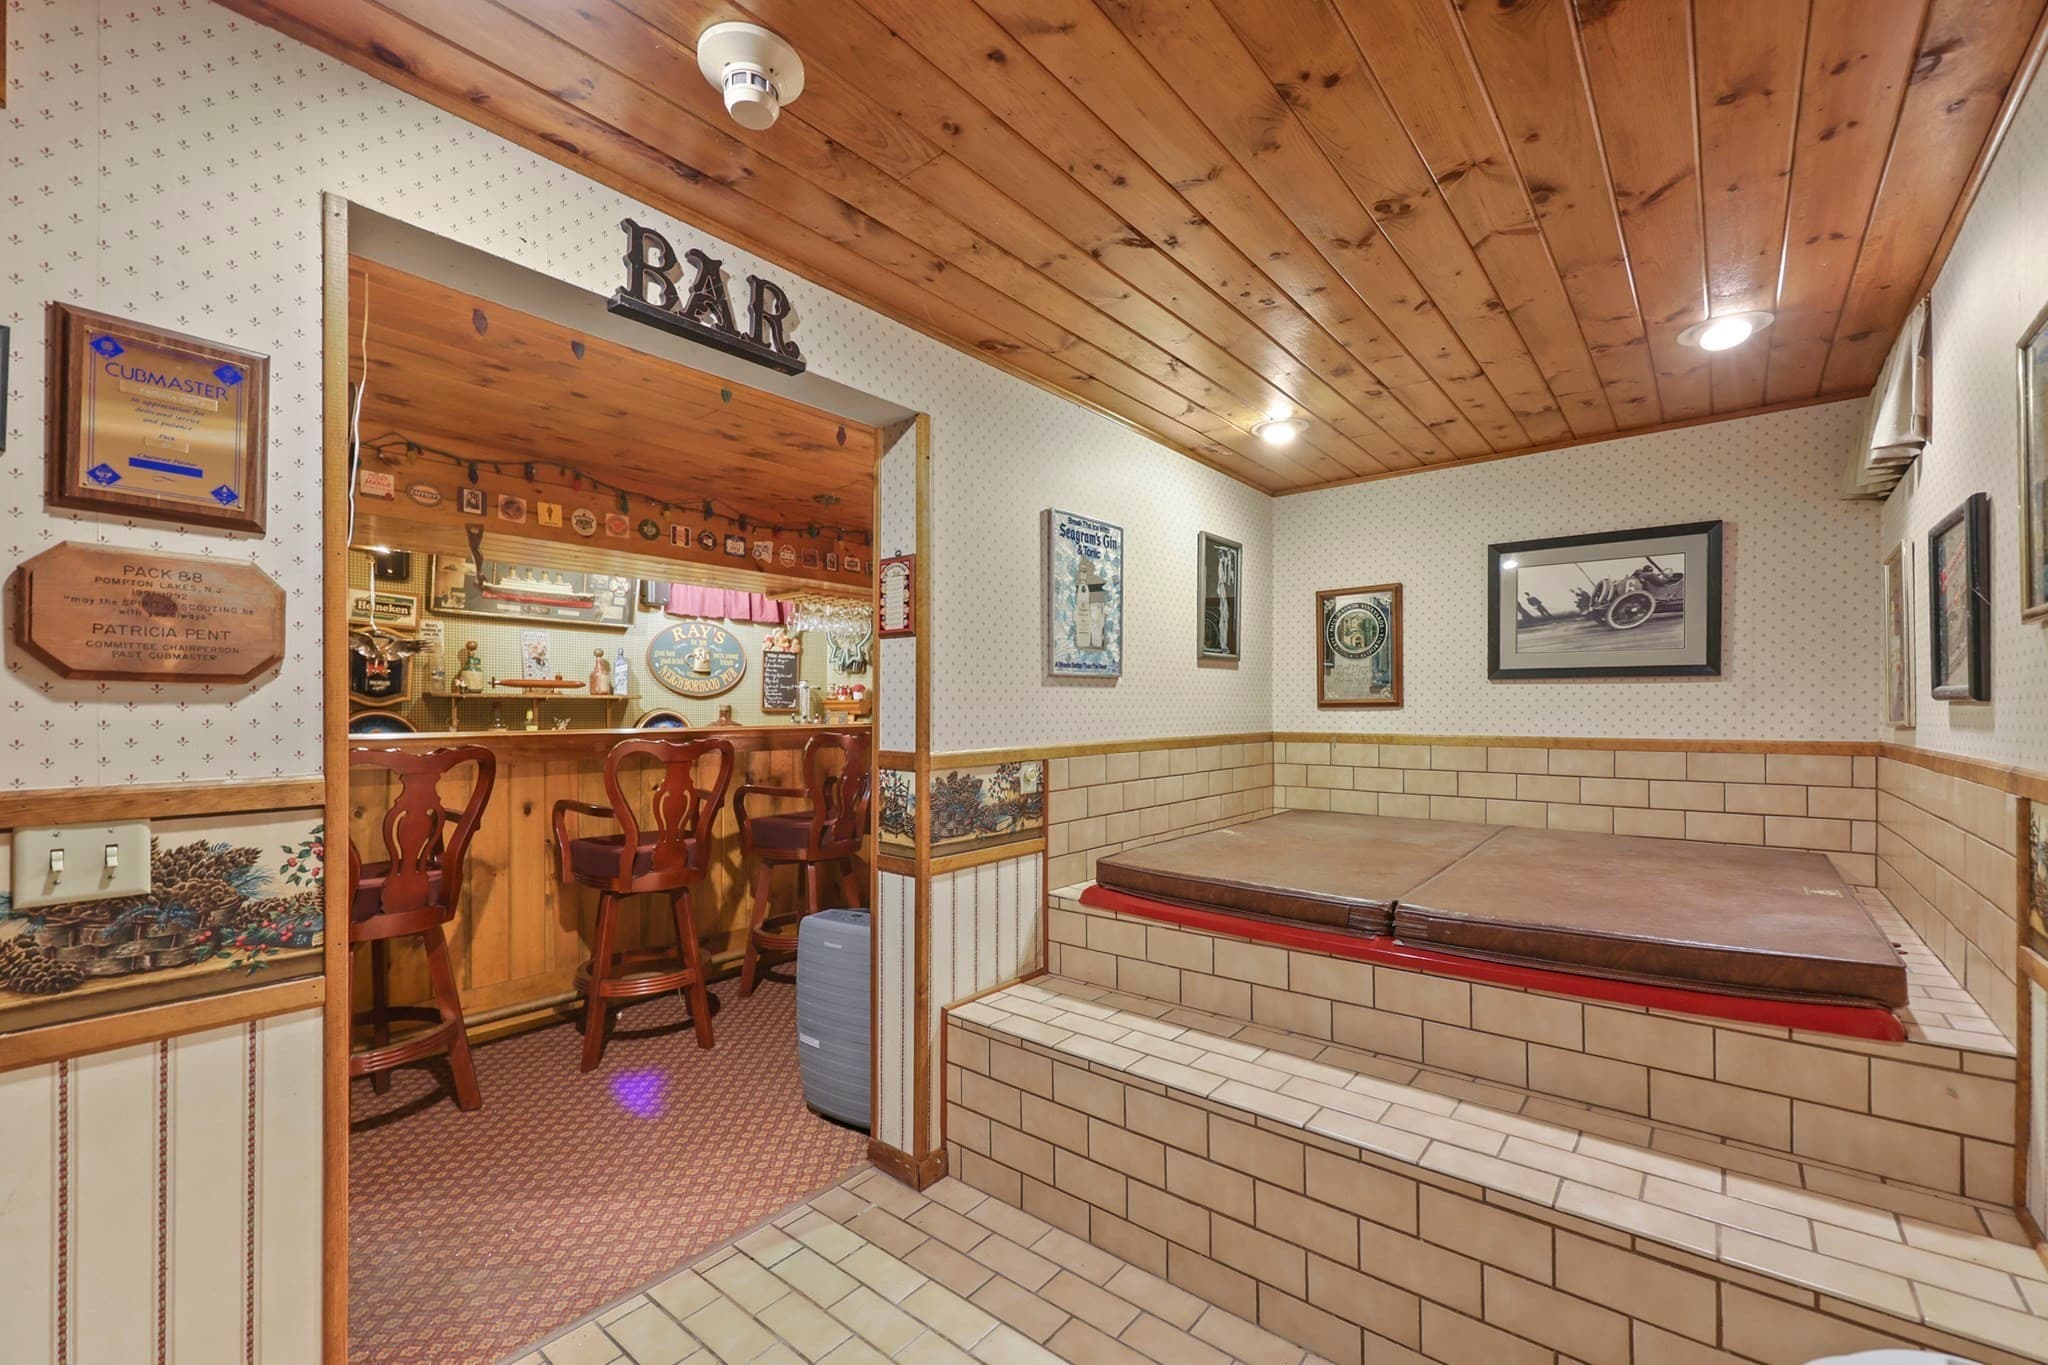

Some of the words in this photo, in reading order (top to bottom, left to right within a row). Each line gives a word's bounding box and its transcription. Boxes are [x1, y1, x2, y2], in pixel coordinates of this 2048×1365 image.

[615, 218, 800, 360] BAR
[105, 361, 228, 401] CUBMASTER
[1059, 522, 1102, 546] Seagram's
[1102, 534, 1118, 551] Gin
[1082, 545, 1101, 559] Tonic
[123, 564, 172, 579] PACK
[94, 576, 153, 588] POMPTON
[181, 603, 238, 614] SCOUTING
[358, 600, 409, 615] Heneken
[91, 622, 177, 638] PATRICIA
[185, 628, 232, 641] PENT
[671, 624, 727, 645] RAY'S
[86, 639, 157, 651] COMMITTEE
[162, 643, 240, 654] CHAIRPERSON
[149, 651, 217, 662] CUBMASTER
[659, 665, 721, 692] NEIGHBORHOOD
